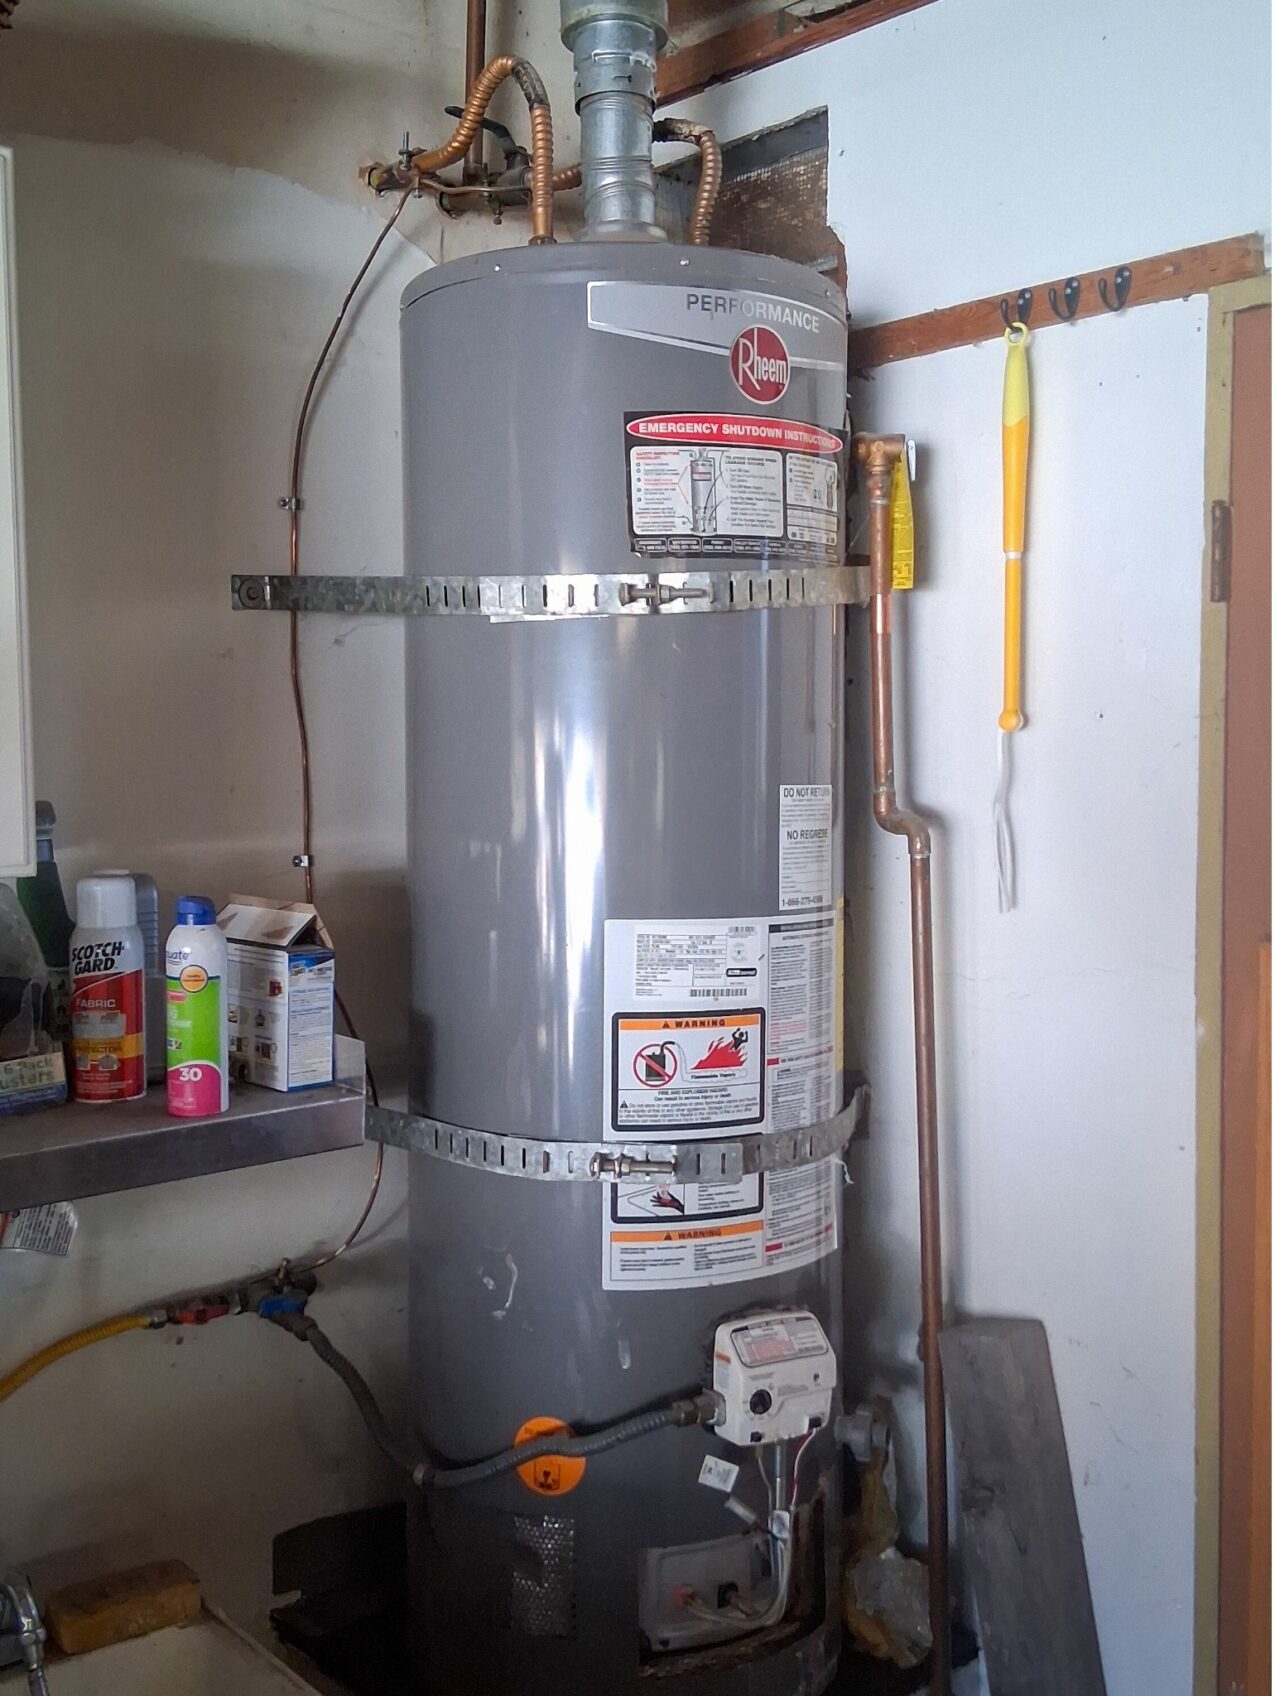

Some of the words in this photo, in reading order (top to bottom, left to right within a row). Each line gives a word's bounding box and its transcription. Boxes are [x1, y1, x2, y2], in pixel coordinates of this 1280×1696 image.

[687, 293, 820, 333] PERFORMANCE
[738, 327, 787, 391] Rheem
[638, 422, 718, 434] EMERGENCY
[722, 423, 782, 439] SHUTDOWN
[784, 429, 836, 449] INSTRUCTIONS
[783, 787, 795, 798] DO
[795, 787, 809, 798] NOT
[786, 829, 799, 841] NO
[800, 828, 829, 840] REGRESE
[71, 941, 123, 962] SCOTCH
[166, 950, 190, 962] uate
[74, 958, 116, 976] GARD
[76, 998, 117, 1008] FABRIC
[675, 1019, 726, 1029] WARNING
[179, 1067, 203, 1082] 30
[678, 1228, 722, 1240] WARNING
